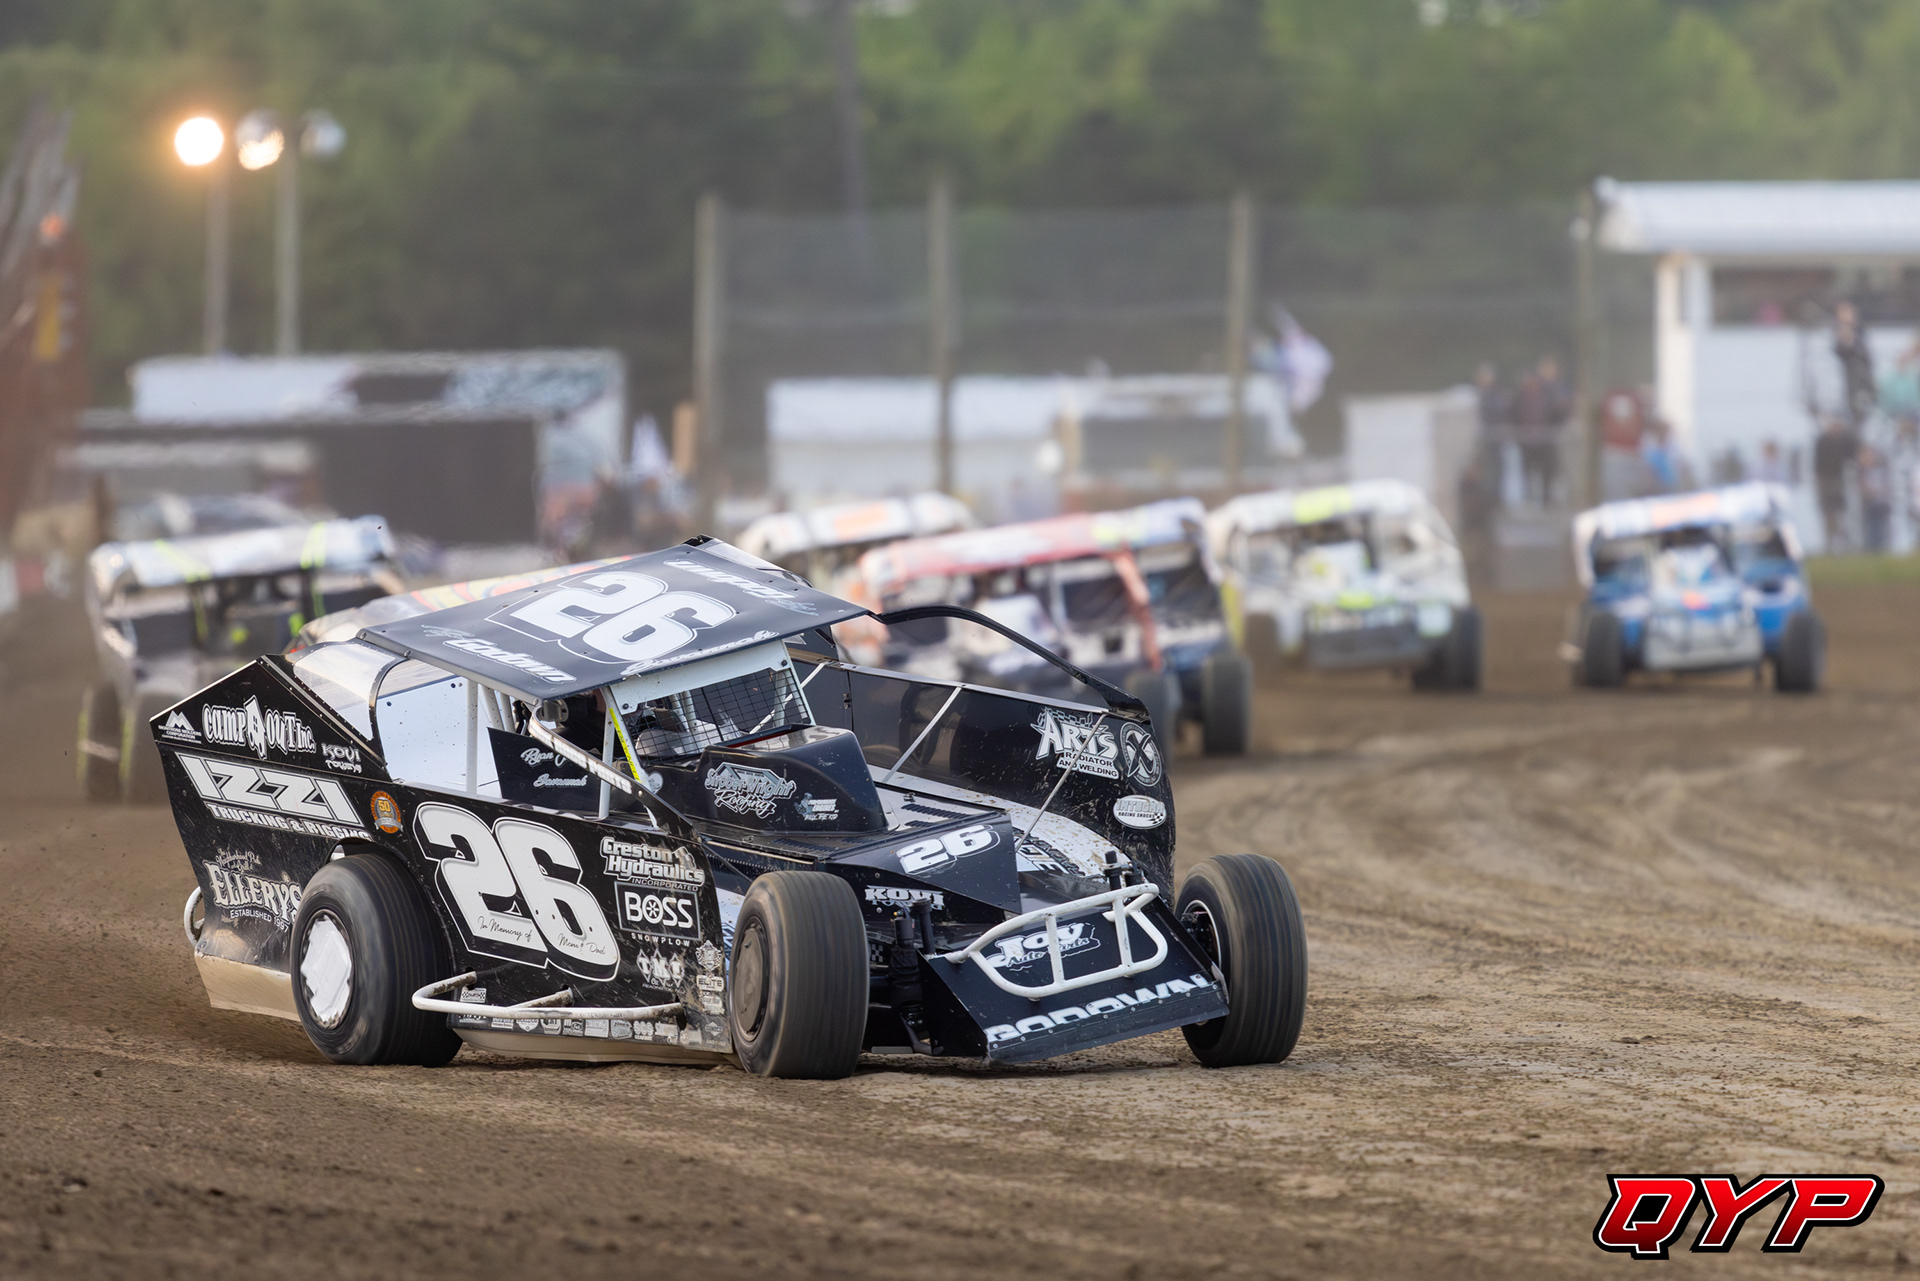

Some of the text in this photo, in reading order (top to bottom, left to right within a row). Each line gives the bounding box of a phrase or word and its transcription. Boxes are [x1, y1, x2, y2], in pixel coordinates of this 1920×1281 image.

[486, 570, 737, 664] 26
[520, 748, 554, 766] Ryan
[1059, 759, 1118, 778] AND WELDING
[1065, 751, 1114, 768] RADIATOR
[174, 751, 365, 828] IZZI
[377, 799, 392, 812] 50
[714, 789, 777, 820] Roofing
[204, 802, 291, 831] TRUCKING
[288, 818, 304, 833] &
[600, 836, 674, 863] Creston
[896, 824, 1001, 876] 26
[604, 855, 706, 887] Hydraulics
[412, 801, 621, 983] 26
[631, 878, 700, 892] INCORPORATED
[864, 885, 945, 907] KOVI
[230, 909, 290, 933] ESTABLISHED 1997
[624, 891, 695, 929] BOSS
[631, 933, 691, 948] SNOWPLOW
[1047, 937, 1091, 952] arts
